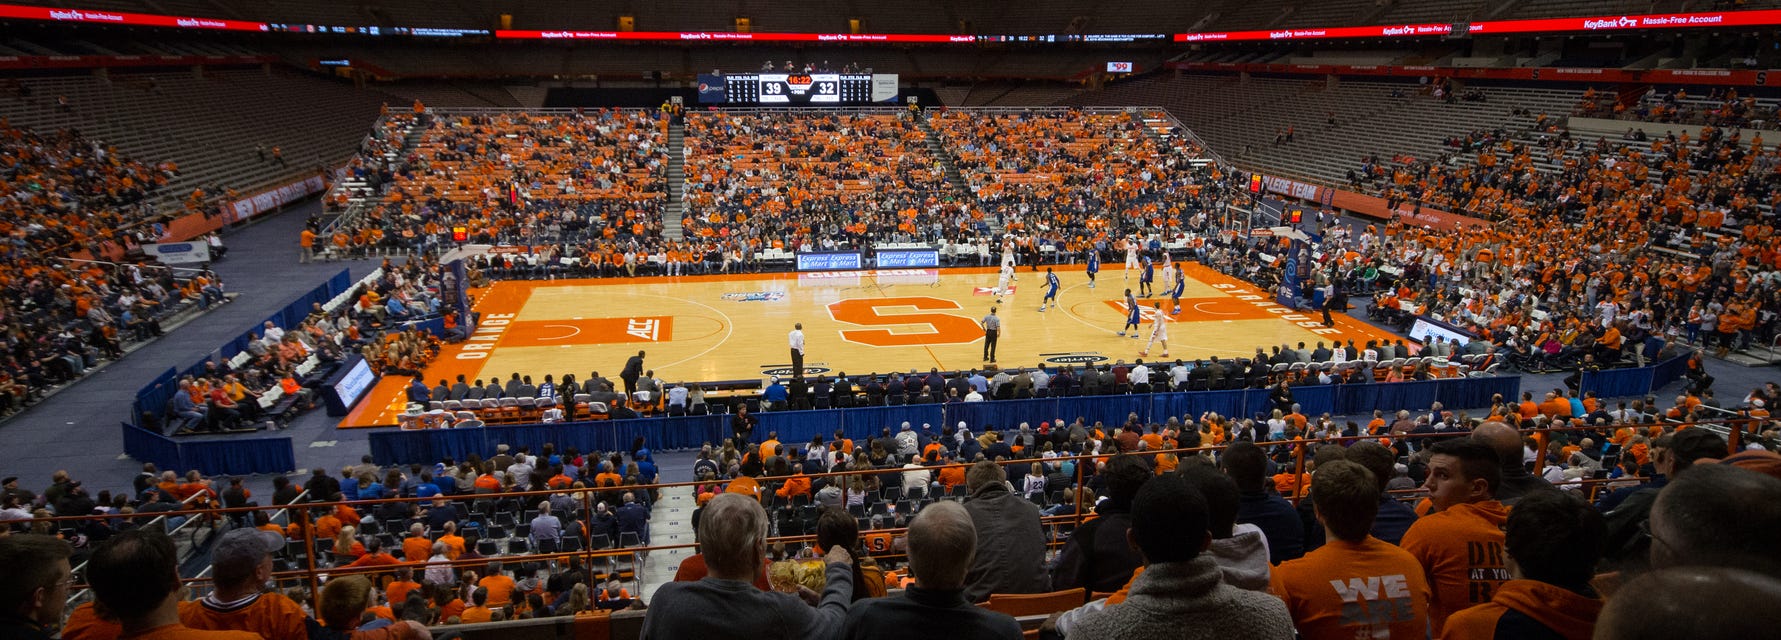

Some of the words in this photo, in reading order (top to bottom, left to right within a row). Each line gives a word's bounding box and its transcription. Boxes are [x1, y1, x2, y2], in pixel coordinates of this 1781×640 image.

[1584, 19, 1618, 30] KeyBank
[1643, 16, 1687, 25] Hassle-Free
[1688, 15, 1722, 24] Account
[1383, 28, 1403, 36] KeyBank
[788, 75, 811, 84] 16:22
[1755, 71, 1767, 85] S
[766, 82, 782, 94] 39
[819, 82, 834, 94] 32
[1292, 182, 1317, 200] TEAM
[830, 254, 856, 262] Express
[881, 252, 907, 260] Express
[917, 257, 935, 265] Mart
[1211, 283, 1343, 335] SYRACUSE
[825, 296, 986, 348] S
[626, 318, 653, 340] ACC
[455, 312, 515, 360] ORANGE
[541, 388, 551, 396] 21
[1033, 481, 1043, 490] 23
[873, 537, 884, 552] S
[1471, 568, 1485, 580] AT
[1329, 574, 1411, 602] WE
[1338, 597, 1416, 625] ARE
